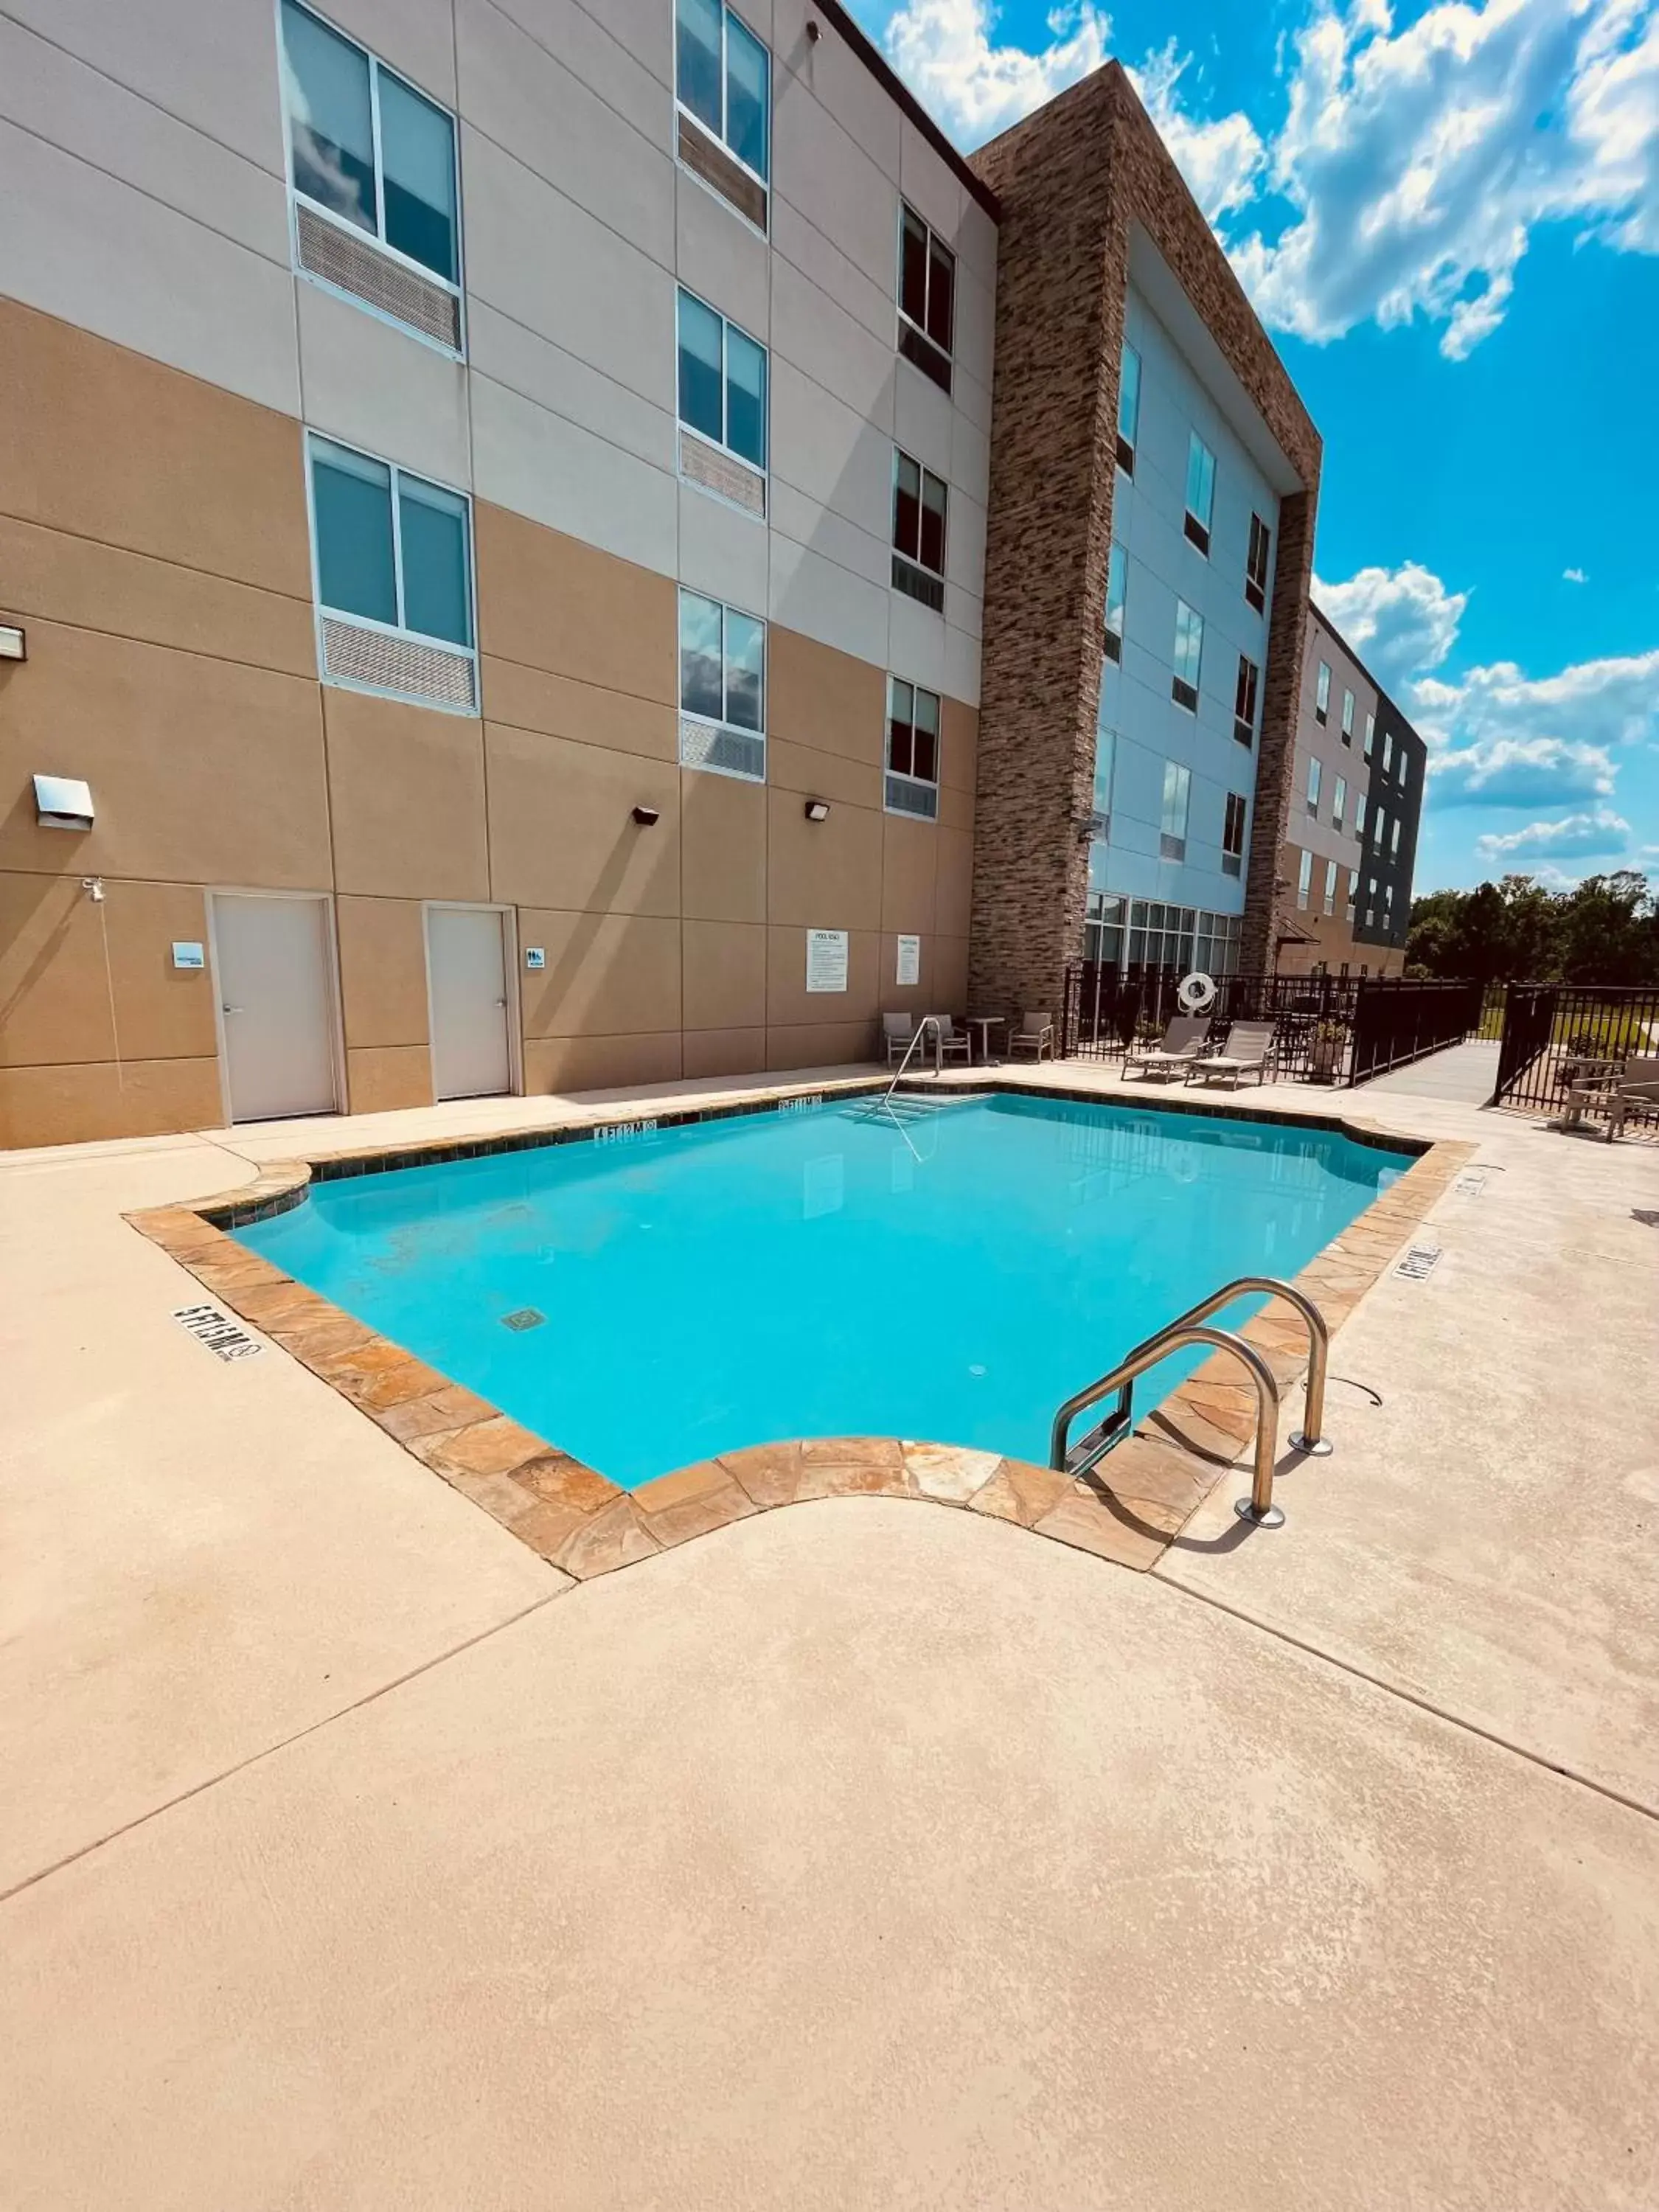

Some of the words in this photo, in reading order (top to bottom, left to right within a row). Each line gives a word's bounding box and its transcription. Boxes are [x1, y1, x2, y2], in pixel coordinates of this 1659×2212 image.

[608, 1126, 619, 1137] FT
[181, 1312, 227, 1329] FT
[204, 1332, 251, 1351] M
